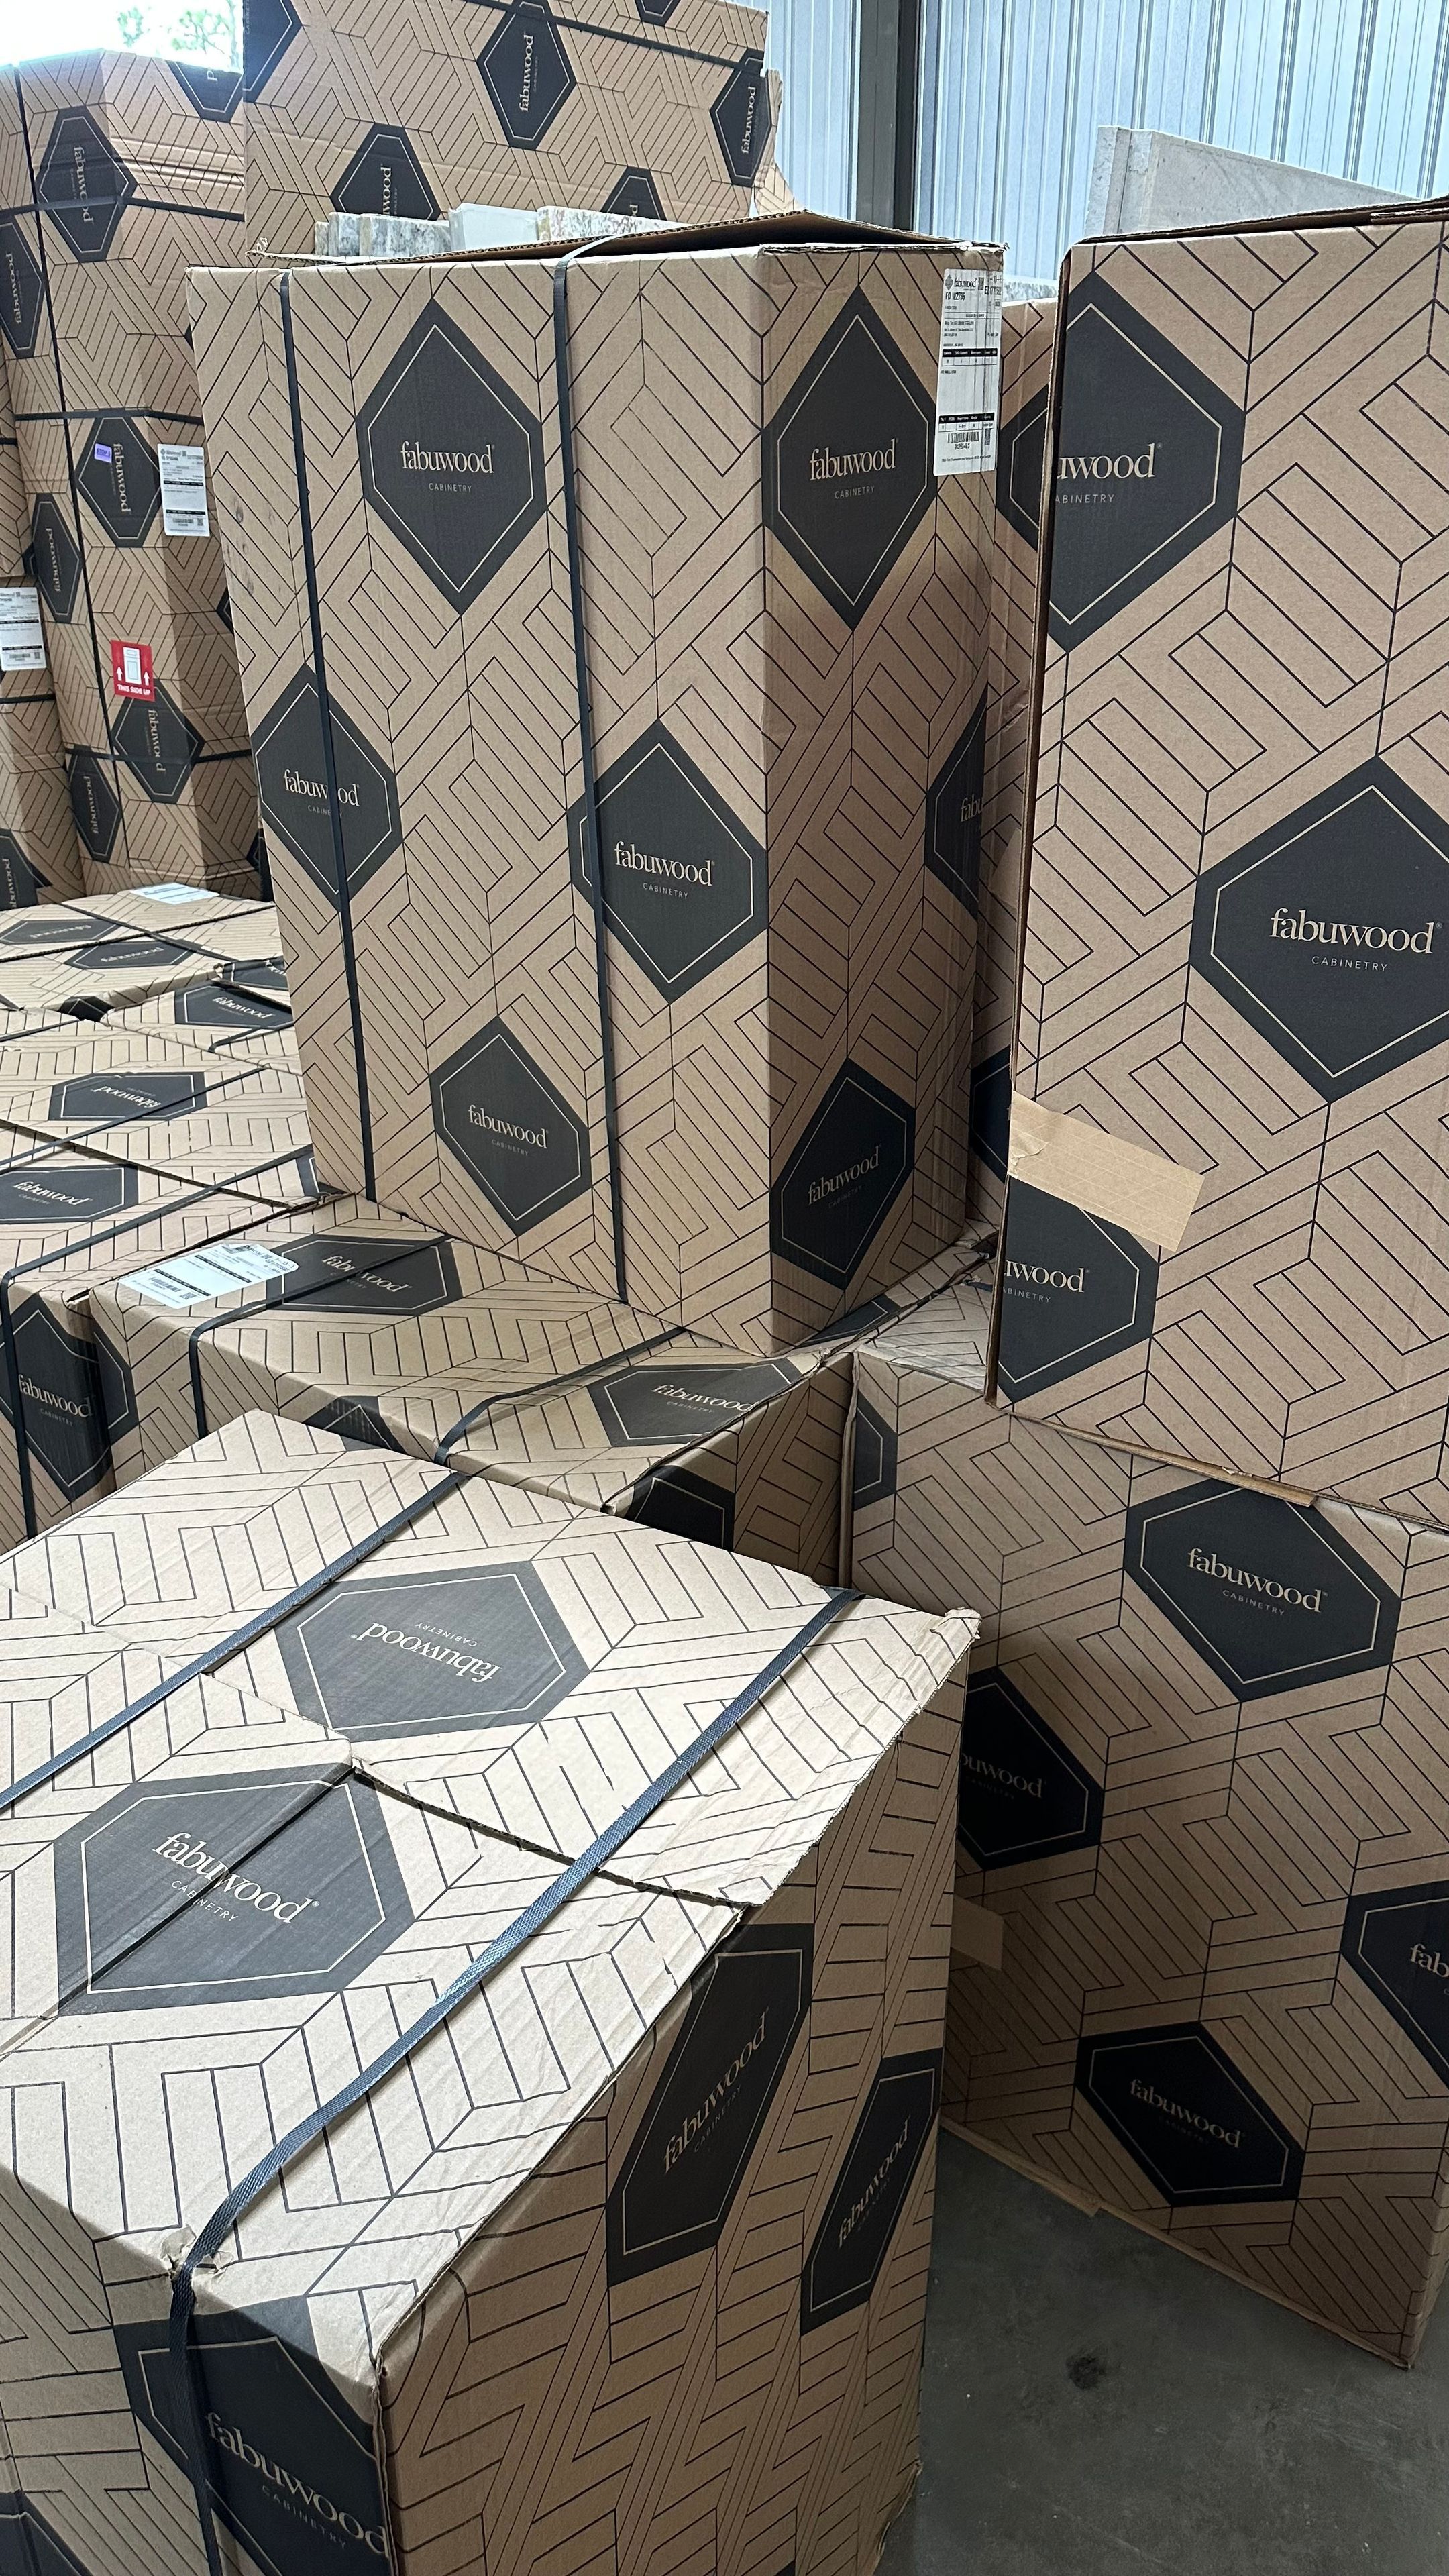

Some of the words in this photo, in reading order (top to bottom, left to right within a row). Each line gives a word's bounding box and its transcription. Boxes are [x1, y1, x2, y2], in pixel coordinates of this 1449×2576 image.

[519, 34, 533, 112] fabuwood
[741, 85, 756, 154] fabuwood
[113, 443, 131, 513] fabuwood
[400, 441, 494, 473] fabuwood
[809, 438, 896, 480] fabuwood
[429, 482, 472, 493] CABINETRY
[835, 486, 875, 499] CABINETRY
[1055, 494, 1114, 503] ABINETRY
[117, 684, 130, 692] THIS
[130, 686, 142, 694] SIDE
[148, 710, 166, 771] fabuwod
[283, 769, 360, 806] fabuwod
[614, 841, 712, 886] fabuwood
[643, 883, 688, 900] CABINETRY
[1269, 908, 1435, 954] fabuwood
[1311, 956, 1388, 972] CABINETRY
[93, 1086, 161, 1108] fabuwood
[468, 1104, 547, 1149] fabuwood
[13, 1181, 90, 1205] fabuwood
[808, 1145, 879, 1205] fabuwood
[321, 1256, 409, 1292] fabood
[18, 1373, 92, 1418] fabuwood
[1188, 1547, 1321, 1613] fabuwood
[1222, 1589, 1285, 1616] CABINETRY
[356, 1622, 502, 1682] fabuwood
[415, 1622, 477, 1647] CABINETRY
[664, 2012, 765, 2175] fabuwood
[1130, 2078, 1240, 2148] fabuwood
[839, 2118, 908, 2248] fabuwood
